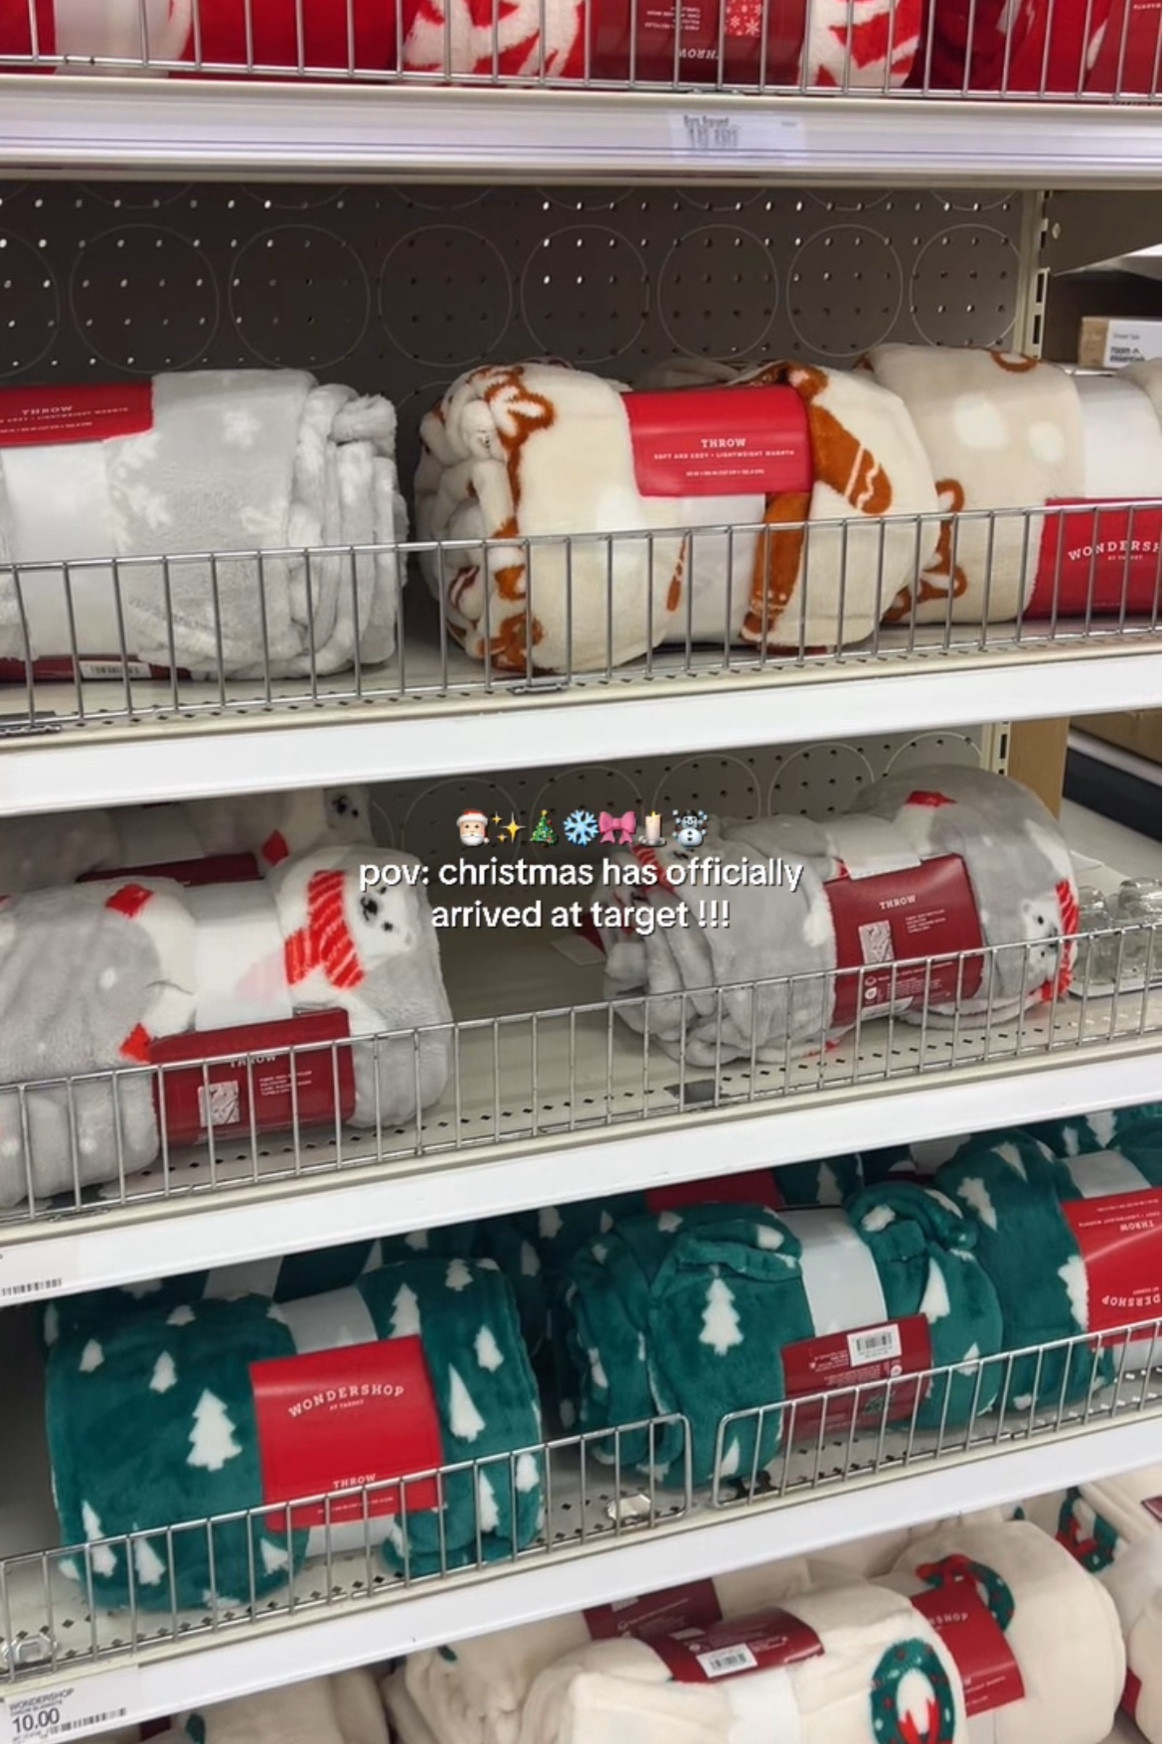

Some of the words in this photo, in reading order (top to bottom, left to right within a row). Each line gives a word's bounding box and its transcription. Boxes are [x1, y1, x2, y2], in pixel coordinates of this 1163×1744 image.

[22, 406, 73, 416] THROW
[700, 438, 747, 449] THROW
[673, 452, 688, 460] AND
[690, 451, 709, 460] COZY
[716, 449, 763, 459] LIGHTWEIGHT
[879, 894, 917, 910] THROW
[1120, 1221, 1155, 1232] THROW
[288, 1384, 404, 1418] WONDERSHOP
[333, 1473, 377, 1489] THROW
[9, 1687, 74, 1711] WONDERSHOP
[12, 1707, 60, 1734] 10.00
